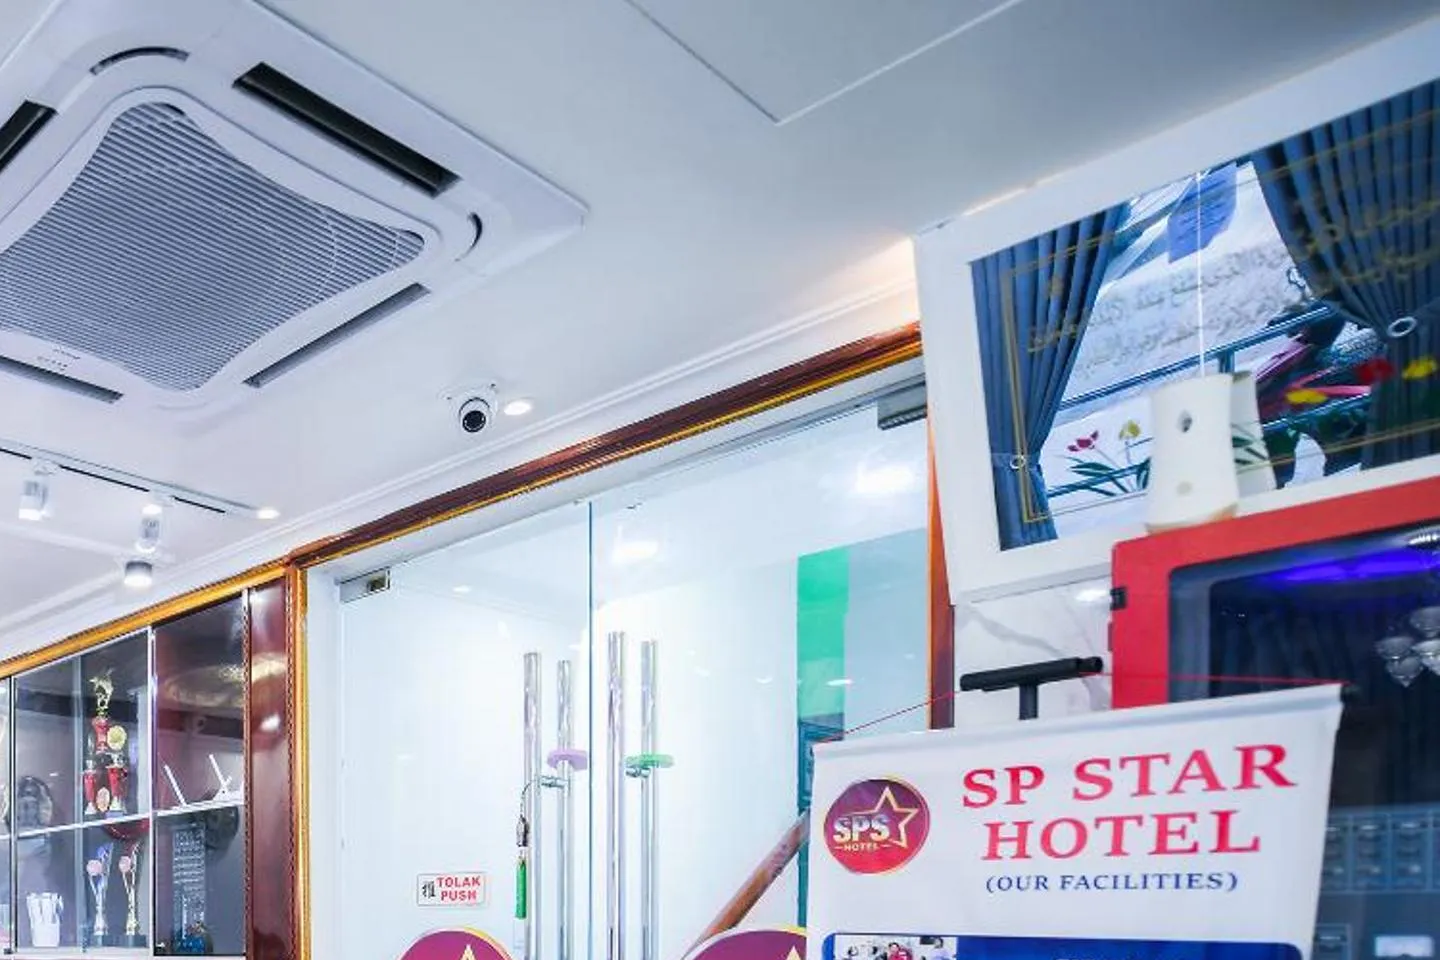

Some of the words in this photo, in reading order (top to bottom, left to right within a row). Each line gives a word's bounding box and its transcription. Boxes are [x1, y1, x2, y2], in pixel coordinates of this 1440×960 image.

[962, 765, 1045, 808] SP
[1072, 743, 1299, 800] STAR
[832, 814, 890, 843] SPS
[980, 809, 1261, 861] HOTEL
[843, 842, 879, 853] HOTEL
[436, 876, 481, 888] TOLAK
[985, 874, 1050, 894] (OUR
[1059, 871, 1239, 892] FACILITIES)
[440, 890, 477, 901] PUSH
